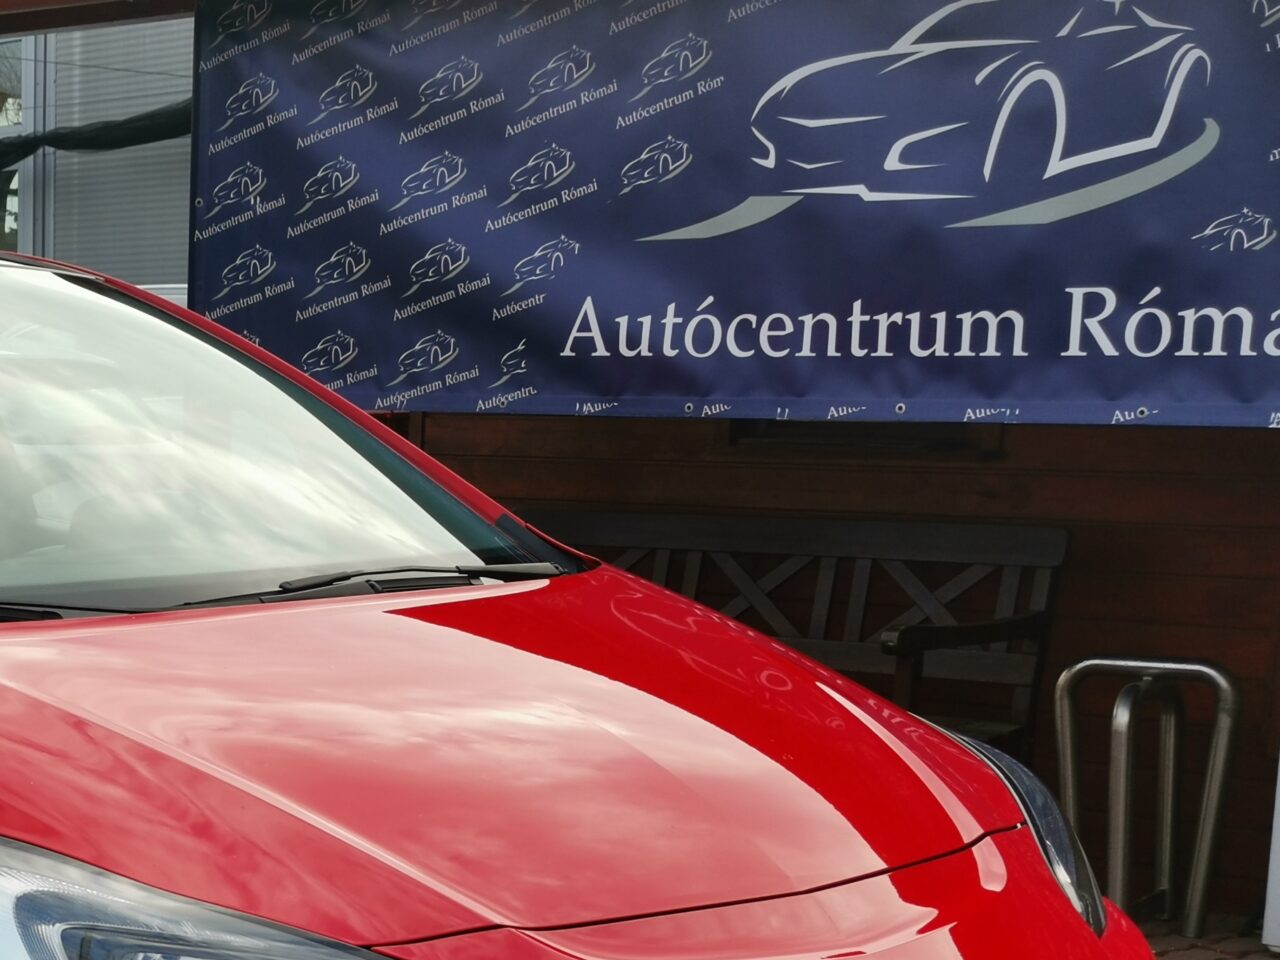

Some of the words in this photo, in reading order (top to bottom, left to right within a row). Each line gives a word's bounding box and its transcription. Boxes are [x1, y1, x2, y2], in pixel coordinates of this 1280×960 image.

[198, 38, 260, 73] Autócentrum
[261, 18, 291, 43] Római
[291, 28, 355, 66] Autócentrum
[357, 10, 391, 34] Római
[389, 20, 460, 57] Autócentrum
[497, 6, 571, 47] Autócentrum
[208, 121, 265, 156] Autócentrum
[266, 104, 298, 130] Római
[296, 115, 364, 150] Autócentrum
[366, 97, 399, 121] Római
[399, 106, 468, 145] Autócentrum
[470, 89, 505, 114] Római
[505, 99, 577, 138] Autócentrum
[580, 79, 618, 105] Római
[616, 90, 695, 130] Autócentrum
[194, 209, 254, 242] Autócentrum
[286, 206, 346, 239] Autócentrum
[347, 188, 380, 212] Római
[379, 202, 449, 236] Autócentrum
[452, 184, 488, 209] Római
[484, 196, 559, 233] Autócentrum
[561, 178, 598, 203] Római
[264, 276, 295, 301] Római
[295, 291, 360, 322] Autócentrum
[361, 275, 392, 298] Római
[393, 290, 457, 321] Autócentrum
[458, 273, 491, 297] Római
[560, 295, 1029, 358] Autócentrum
[346, 364, 379, 384] Római
[374, 380, 443, 410] Autócentrum
[445, 365, 480, 388] Római
